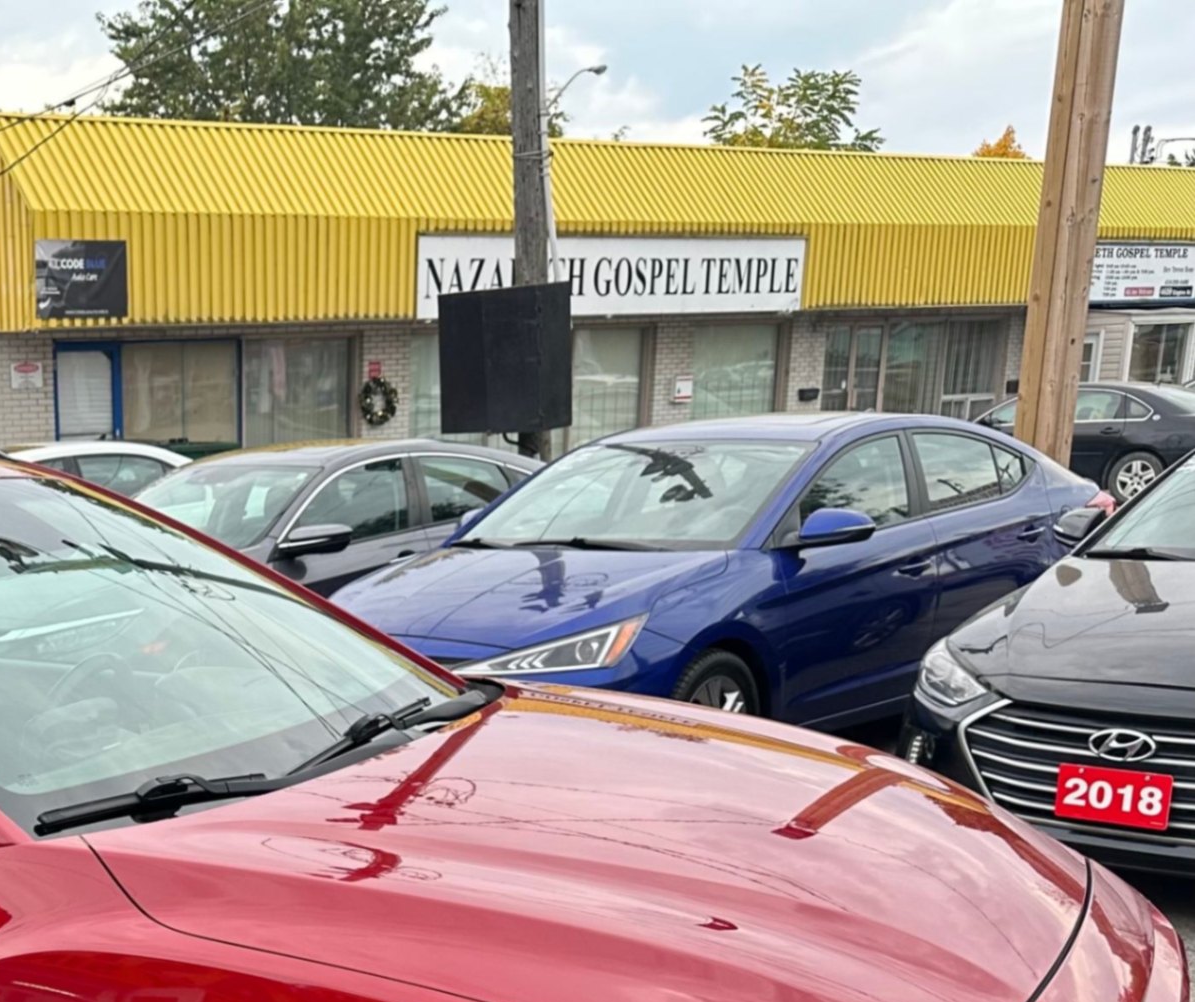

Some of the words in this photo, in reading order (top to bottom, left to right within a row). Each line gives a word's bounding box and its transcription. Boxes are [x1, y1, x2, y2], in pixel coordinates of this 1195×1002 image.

[1116, 247, 1152, 259] GOSPEL
[1154, 247, 1189, 259] TEMPLE
[593, 256, 696, 296] GOSPEL
[701, 256, 799, 294] TEMPLE
[1062, 777, 1164, 816] 2018
